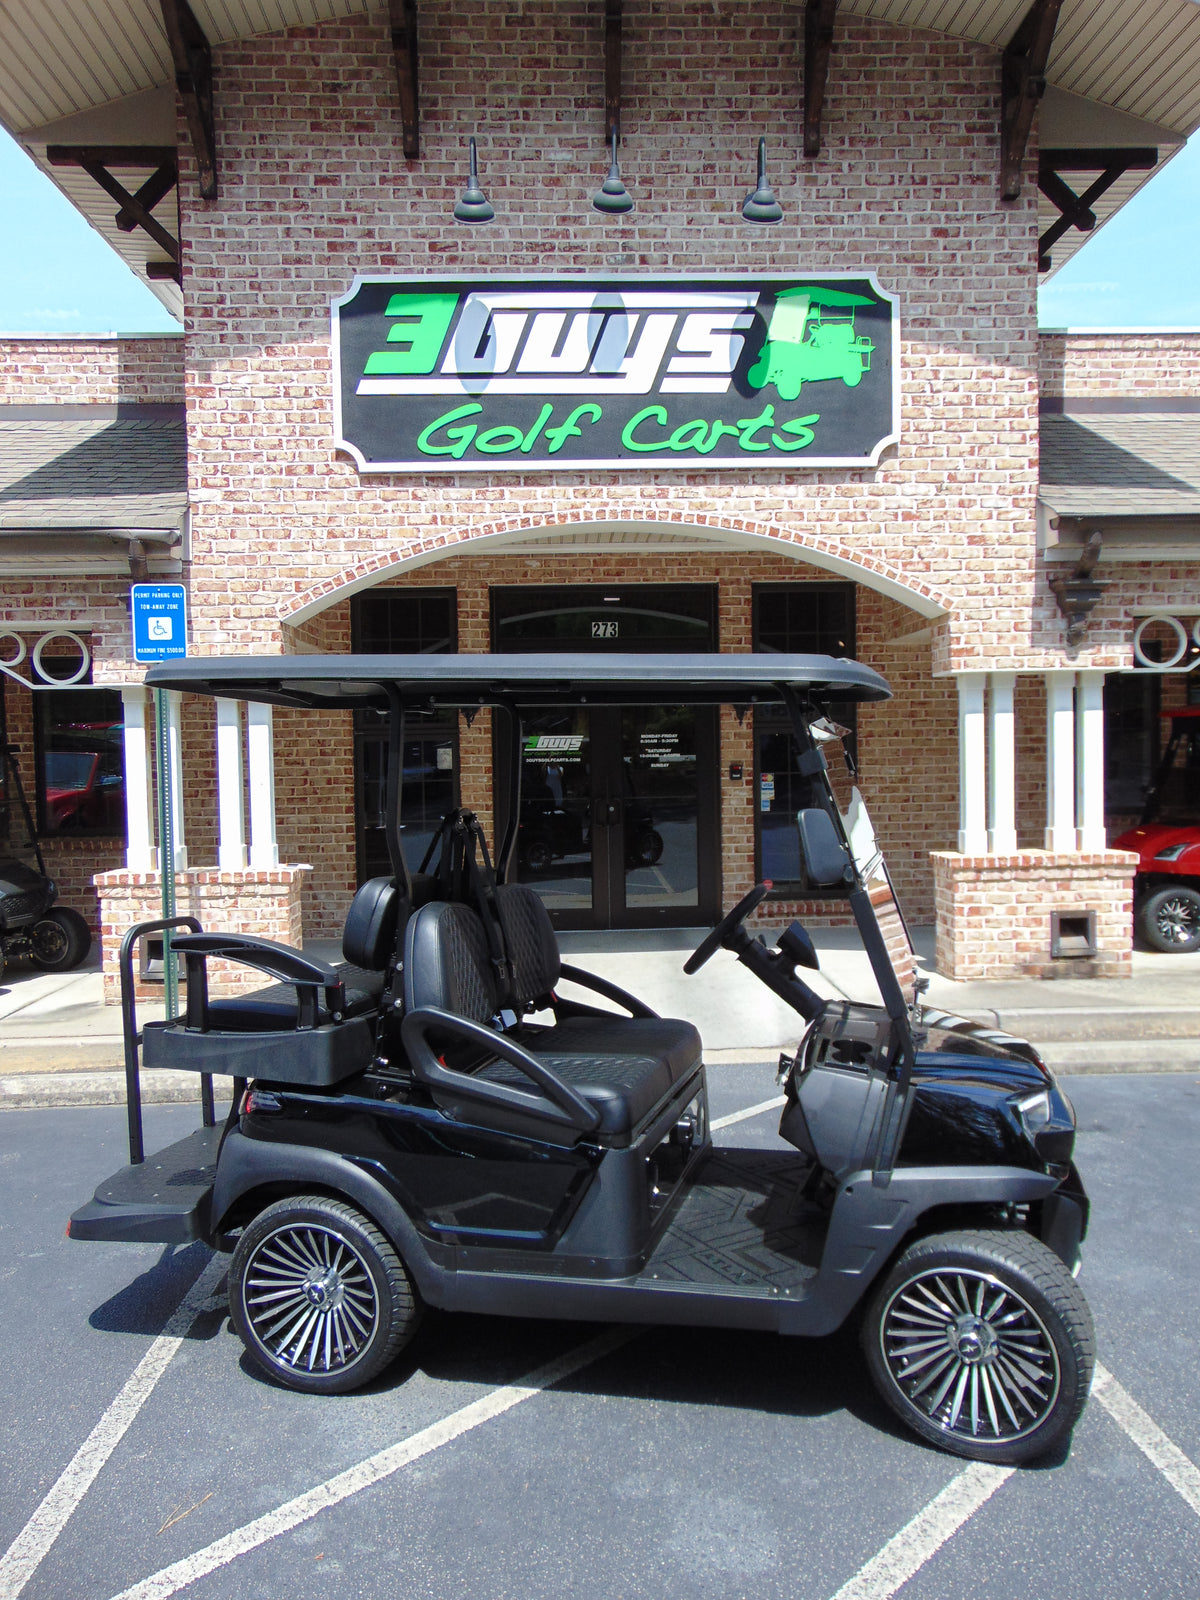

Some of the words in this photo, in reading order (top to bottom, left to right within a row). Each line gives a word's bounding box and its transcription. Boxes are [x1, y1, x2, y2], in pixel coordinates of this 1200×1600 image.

[417, 403, 602, 459] Golf
[622, 404, 821, 454] Carts
[593, 622, 617, 637] 273
